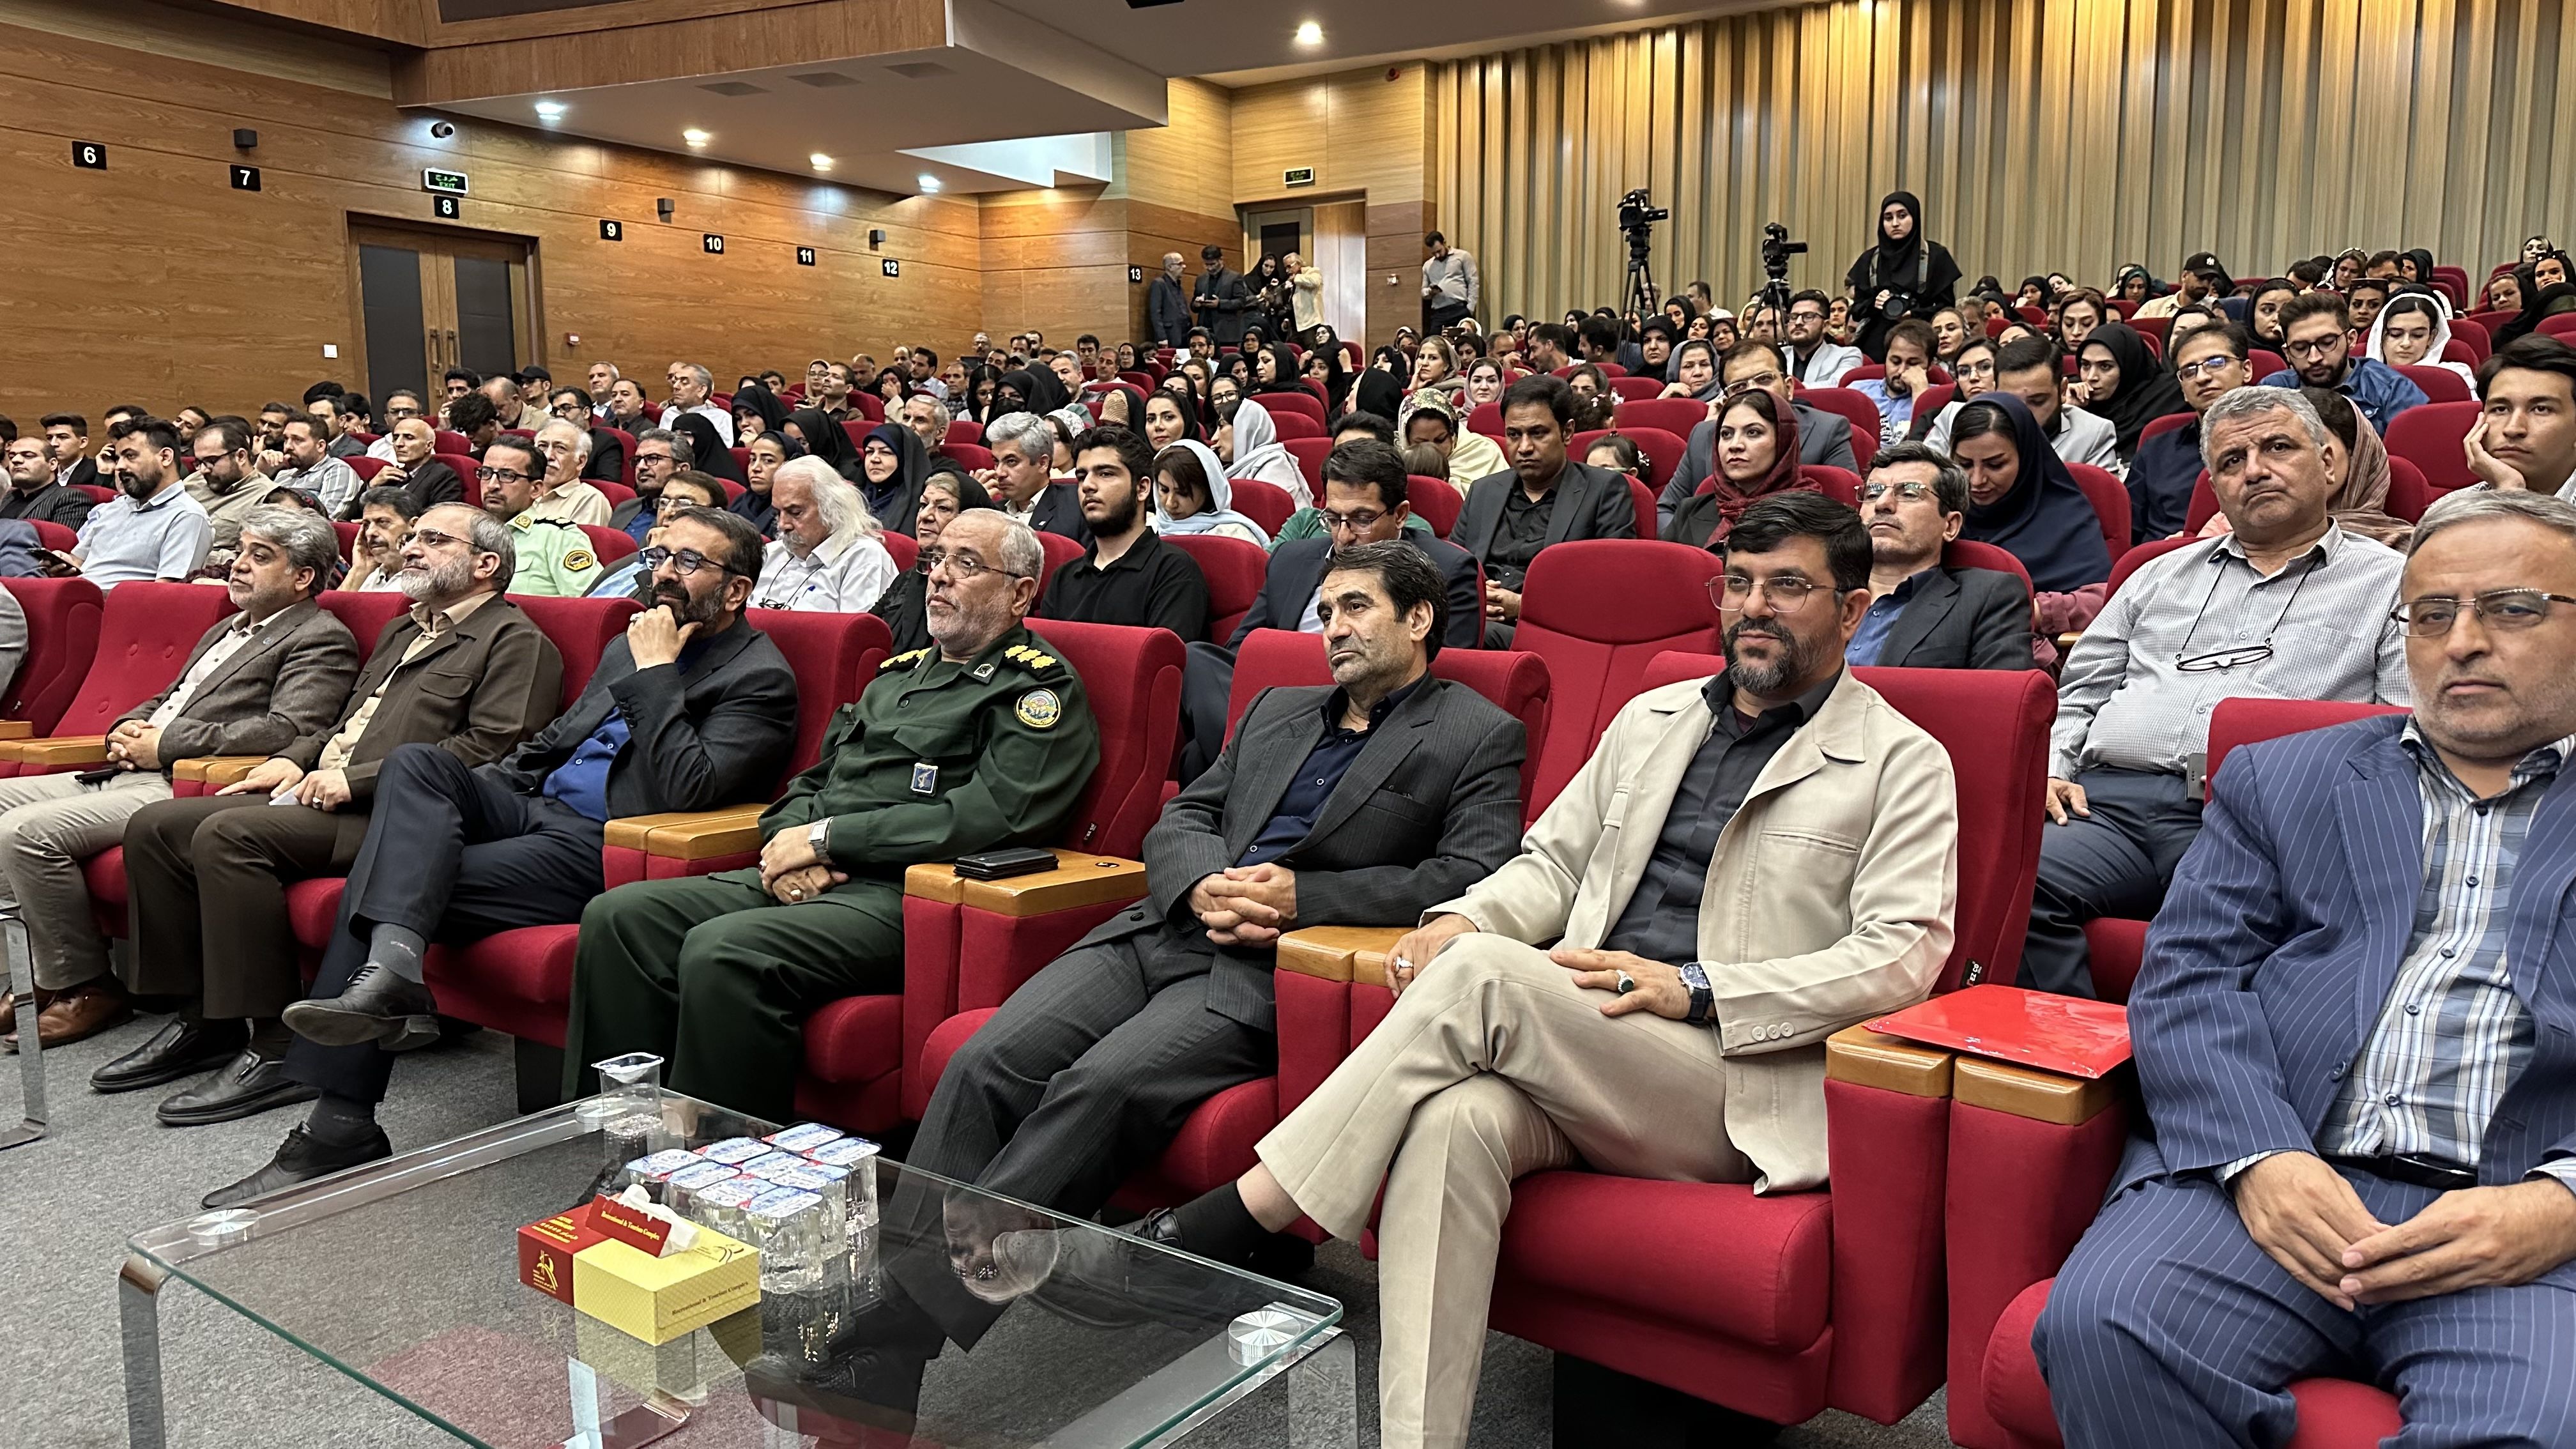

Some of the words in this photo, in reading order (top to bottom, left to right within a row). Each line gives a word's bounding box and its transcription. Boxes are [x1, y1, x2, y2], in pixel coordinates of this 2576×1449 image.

[83, 146, 96, 164] 6
[240, 169, 250, 186] 7
[442, 199, 452, 215] 8
[606, 222, 617, 237] 9
[706, 236, 723, 251] 10
[800, 249, 813, 263] 11
[884, 261, 898, 275] 12
[1130, 268, 1142, 280] 13
